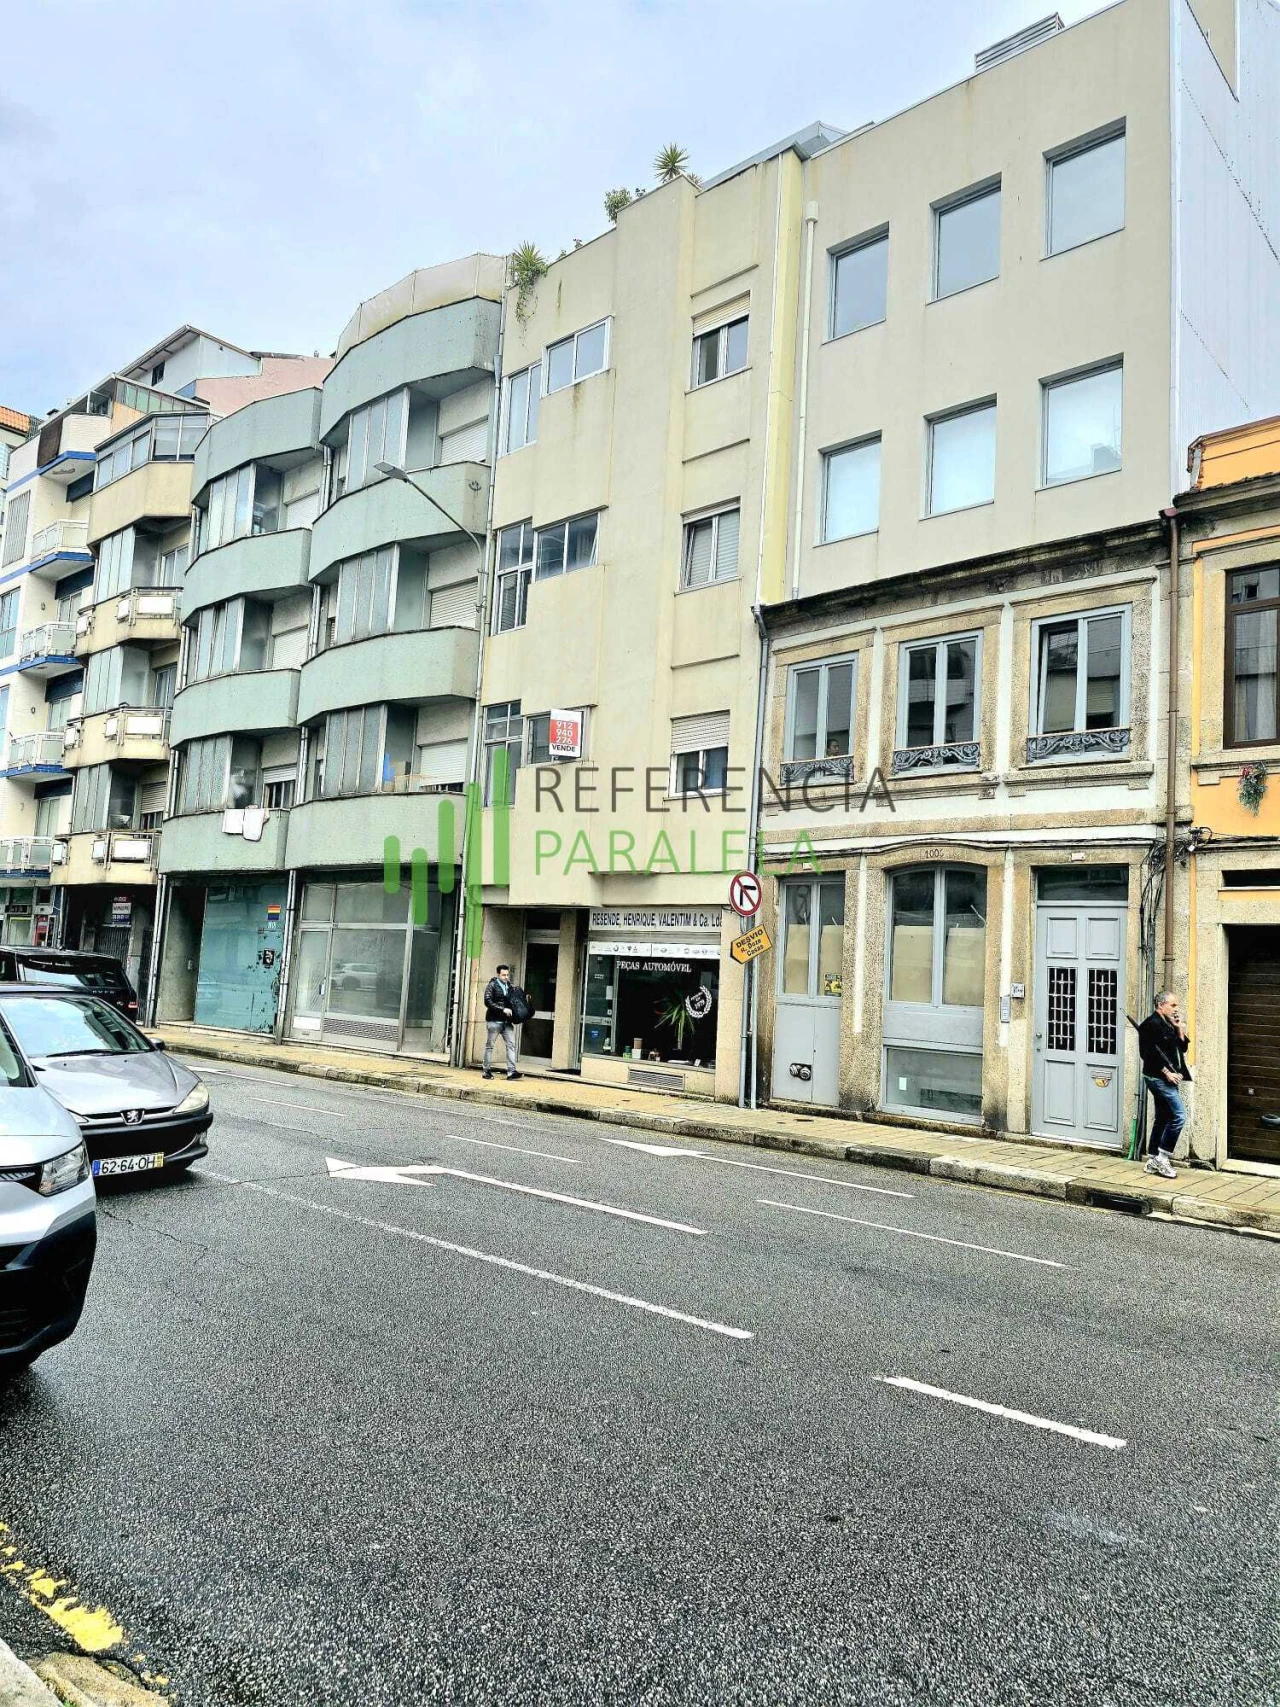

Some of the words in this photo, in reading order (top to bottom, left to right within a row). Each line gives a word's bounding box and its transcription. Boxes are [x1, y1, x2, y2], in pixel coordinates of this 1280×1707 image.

[556, 721, 573, 730] 912
[552, 744, 576, 752] VENDE
[592, 912, 621, 928] RESENDE,
[623, 912, 656, 928] HENRIQUE,
[658, 912, 691, 927] VALENTIM
[692, 913, 698, 927] &
[736, 930, 763, 948] DESVIO
[747, 939, 761, 949] Doze
[616, 961, 640, 971] PEÇAS
[642, 961, 692, 973] AUTOMÓVEL
